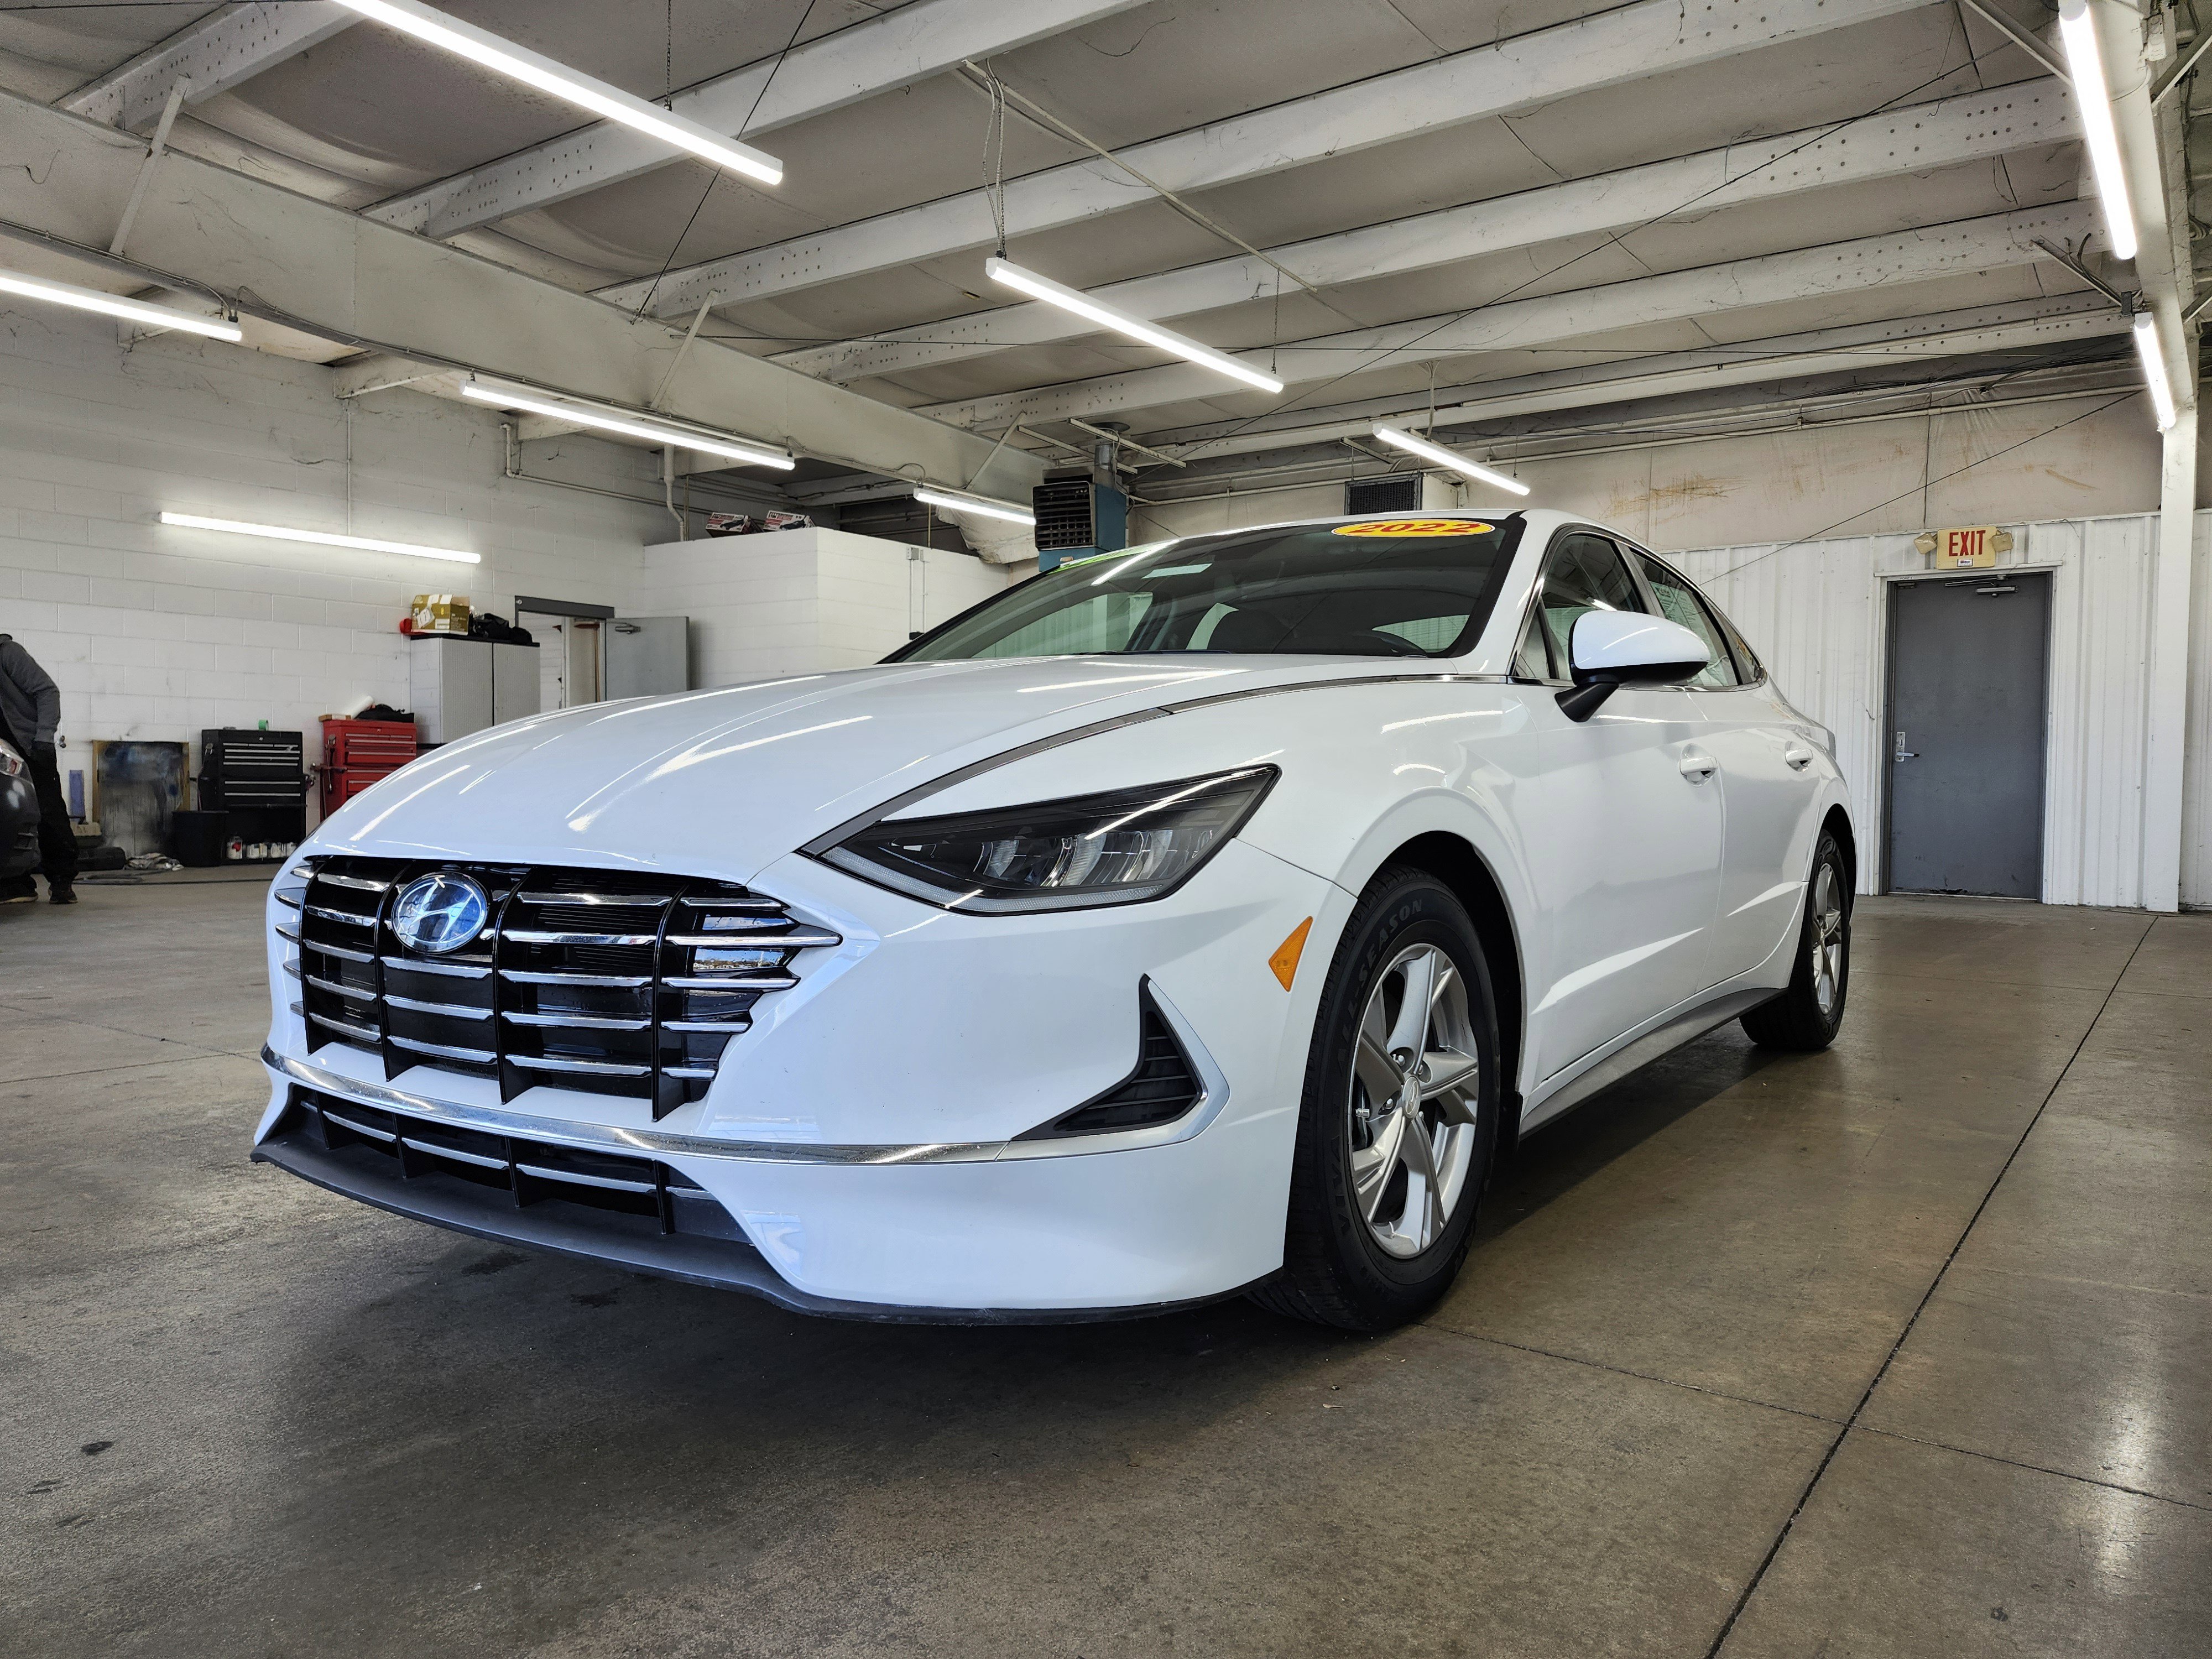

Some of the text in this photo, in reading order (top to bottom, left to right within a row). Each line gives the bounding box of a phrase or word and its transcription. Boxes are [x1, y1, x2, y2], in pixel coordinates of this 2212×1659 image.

[1345, 523, 1480, 533] 2022
[1949, 530, 1986, 556] EXIT
[1337, 899, 1423, 1077] ALL-SEASON
[1331, 1134, 1350, 1237] VIVA
